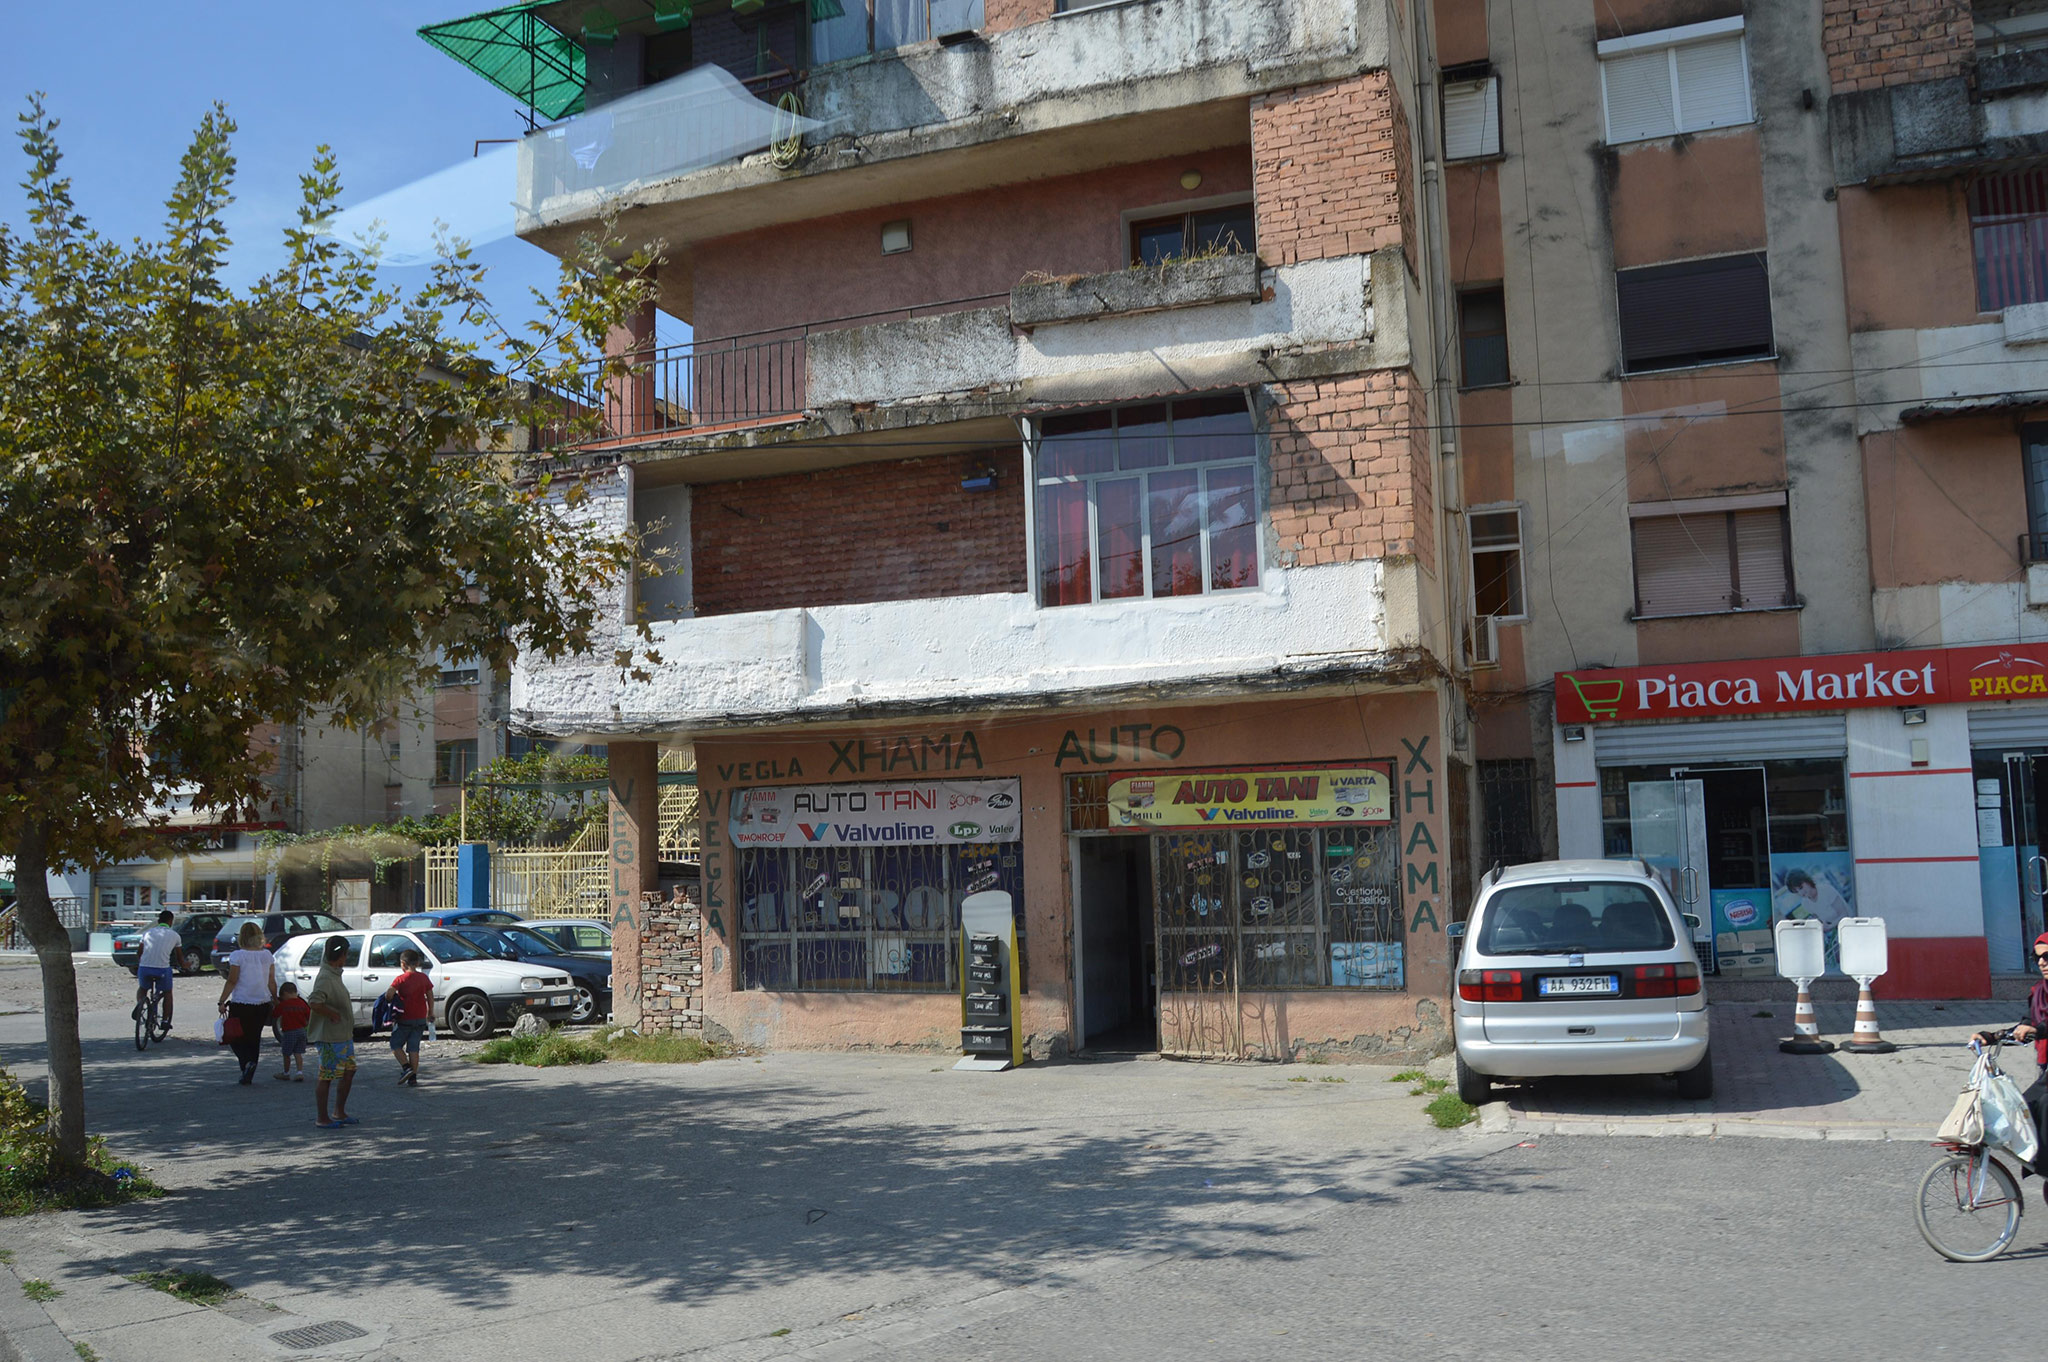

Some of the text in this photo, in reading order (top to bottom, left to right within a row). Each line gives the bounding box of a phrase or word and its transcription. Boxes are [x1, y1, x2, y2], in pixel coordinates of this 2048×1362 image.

[1637, 661, 1936, 710] Piaca Market
[1969, 673, 2048, 697] PIACA
[828, 730, 983, 775] XHAMA
[1054, 723, 1185, 768] AUTO
[717, 756, 804, 783] VEGLA
[1340, 776, 1377, 786] VARTA
[1131, 781, 1154, 789] FIAMM
[1171, 775, 1320, 805] AUTO TANI
[794, 789, 937, 813] AUTO TANI
[1224, 807, 1295, 821] Valvoline
[743, 833, 780, 843] MONROE
[834, 822, 935, 841] Valvoline
[954, 825, 978, 836] Lpr
[989, 825, 1014, 834] Valeo
[1400, 735, 1441, 934] XHAMA
[611, 778, 637, 930] VEGLA
[704, 789, 727, 938] VEGLA
[1550, 977, 1609, 992] AA 932FN
